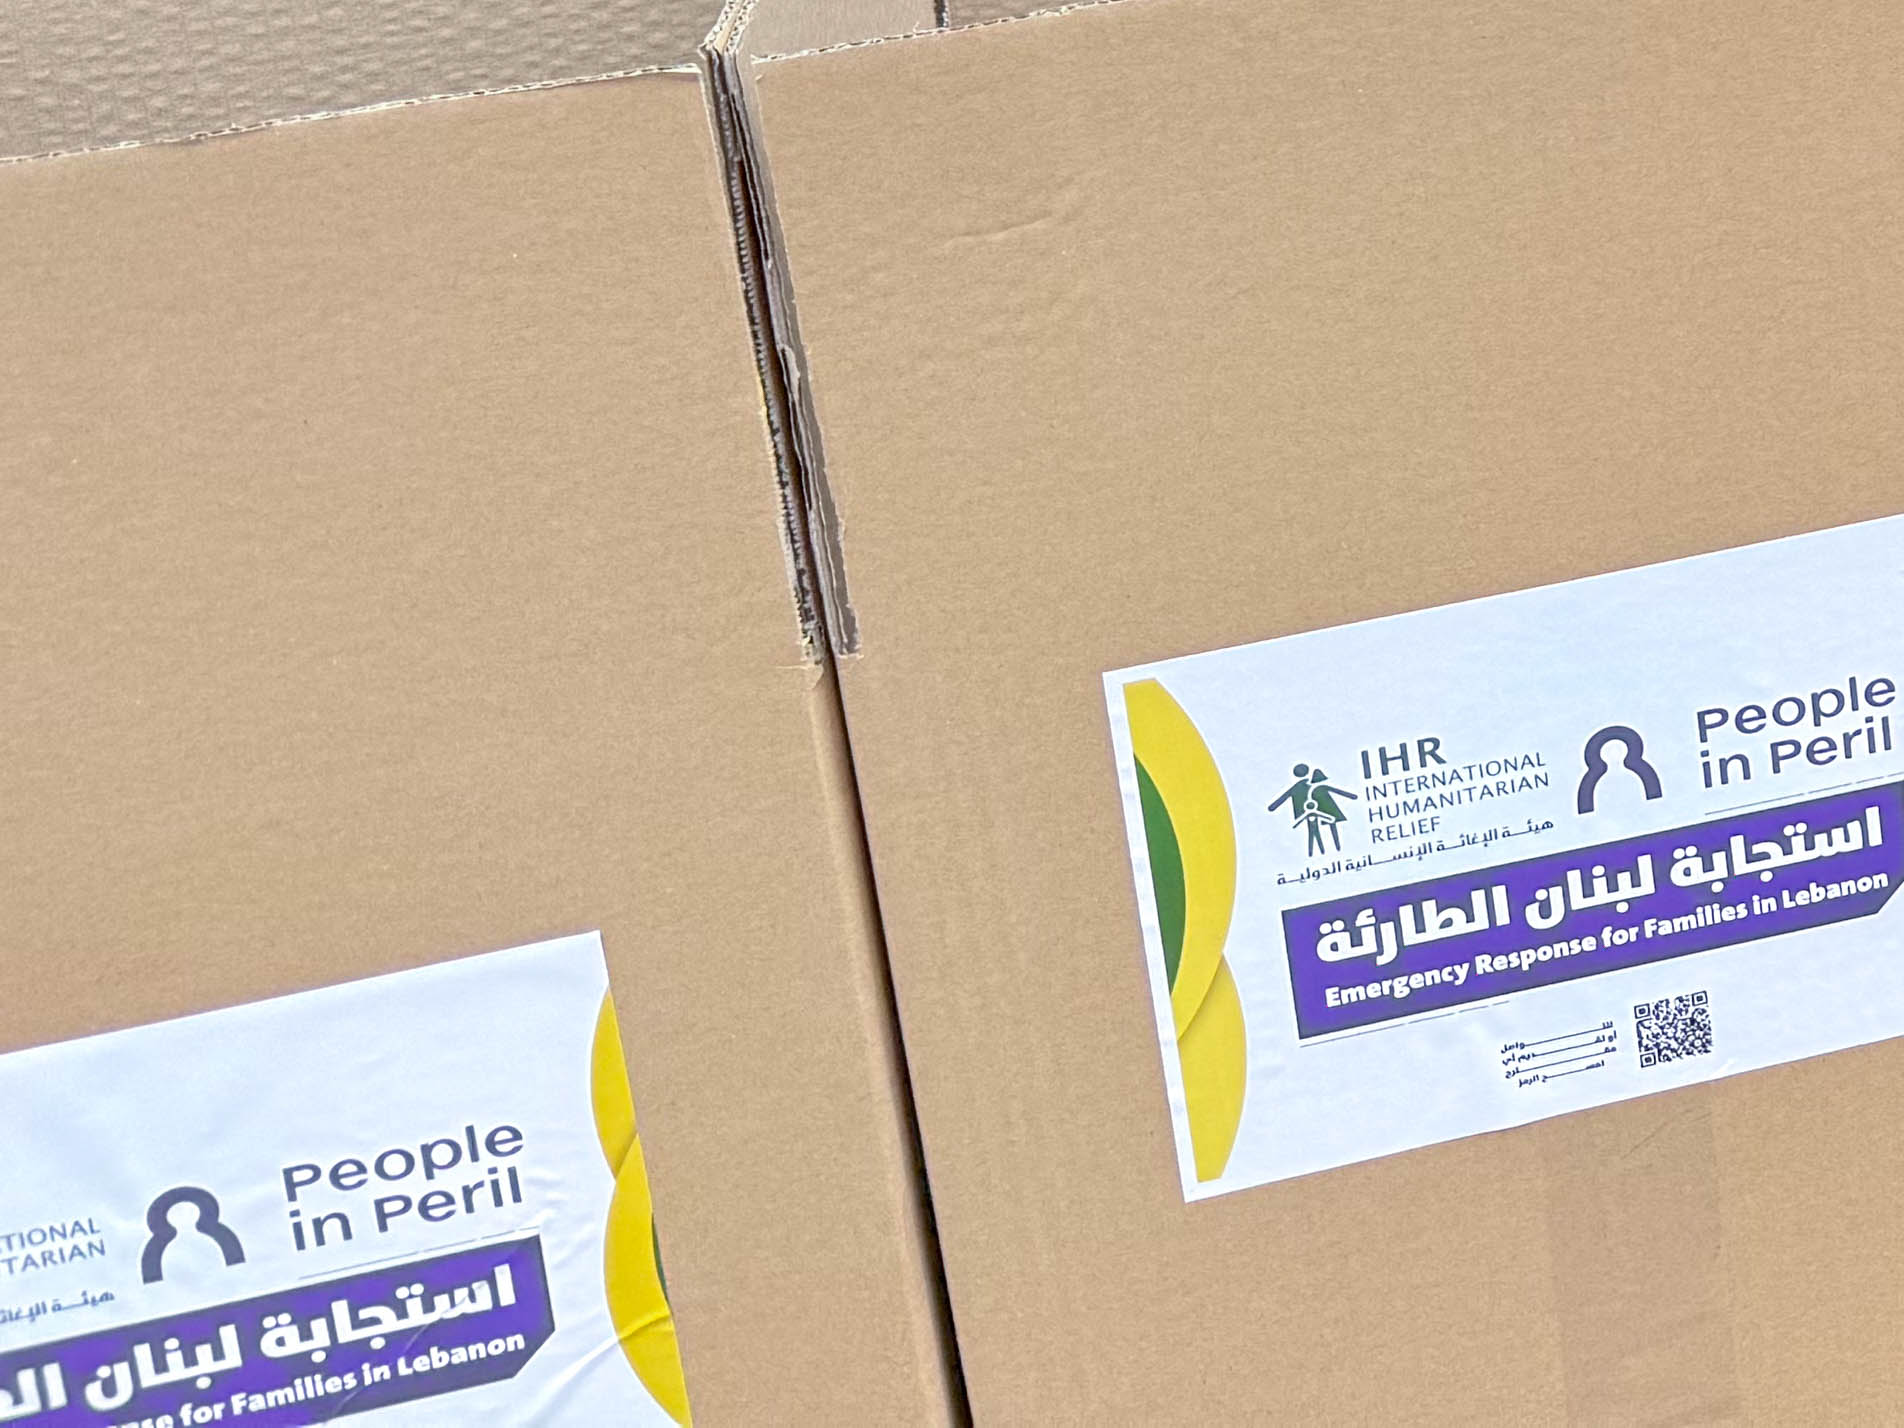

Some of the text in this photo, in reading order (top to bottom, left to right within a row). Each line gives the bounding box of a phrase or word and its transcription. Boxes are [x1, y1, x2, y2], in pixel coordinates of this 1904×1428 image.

[1696, 676, 1896, 744] People
[1360, 736, 1447, 780] IHR
[1365, 751, 1546, 802] INTERNATIONAL
[1700, 715, 1892, 789] in Peril
[1368, 771, 1549, 824] HUMANITARIAN
[1371, 815, 1440, 844] RELIEF
[1316, 806, 1883, 966] استجابة لبنان الطارئة
[1325, 872, 1889, 1008] Emergency Response for Families in Lebanon
[282, 1124, 524, 1203] People
[289, 1166, 523, 1251] in Peril
[259, 1263, 516, 1363] استجابة
[84, 1323, 243, 1411] لبنان
[179, 1402, 226, 1427] for
[230, 1372, 358, 1416] Families
[361, 1362, 391, 1387] in
[397, 1333, 526, 1376] Lebanon
